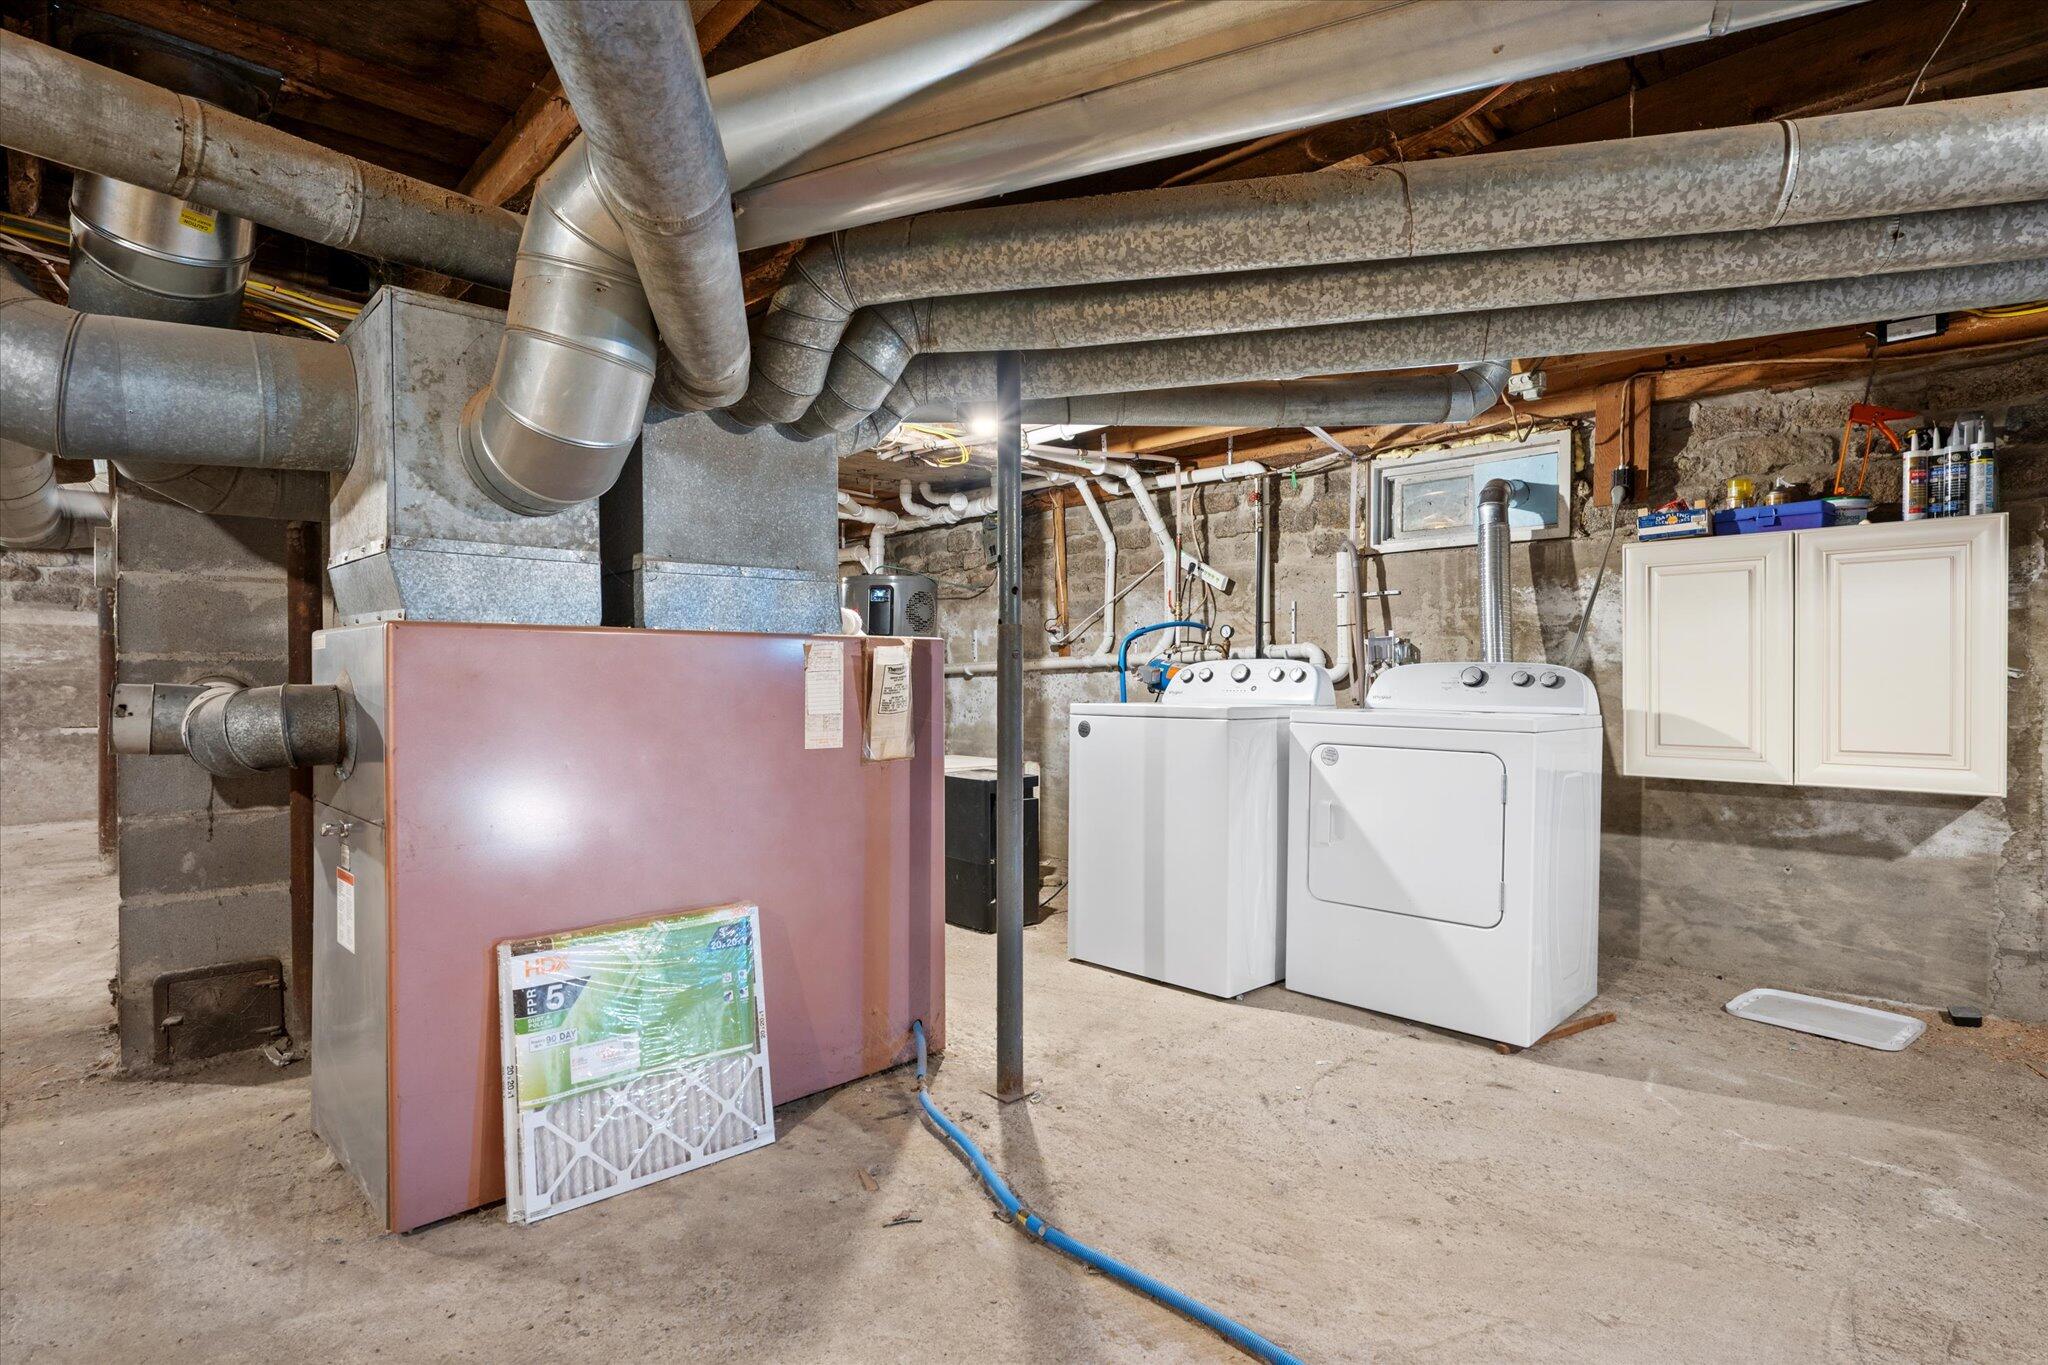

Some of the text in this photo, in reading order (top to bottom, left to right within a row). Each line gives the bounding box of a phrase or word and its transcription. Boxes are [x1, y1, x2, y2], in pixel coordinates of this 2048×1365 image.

[184, 219, 208, 231] CAUTION
[524, 956, 569, 978] HDX
[527, 988, 537, 1015] FPR
[545, 983, 565, 1011] 5
[560, 1029, 577, 1040] DAY
